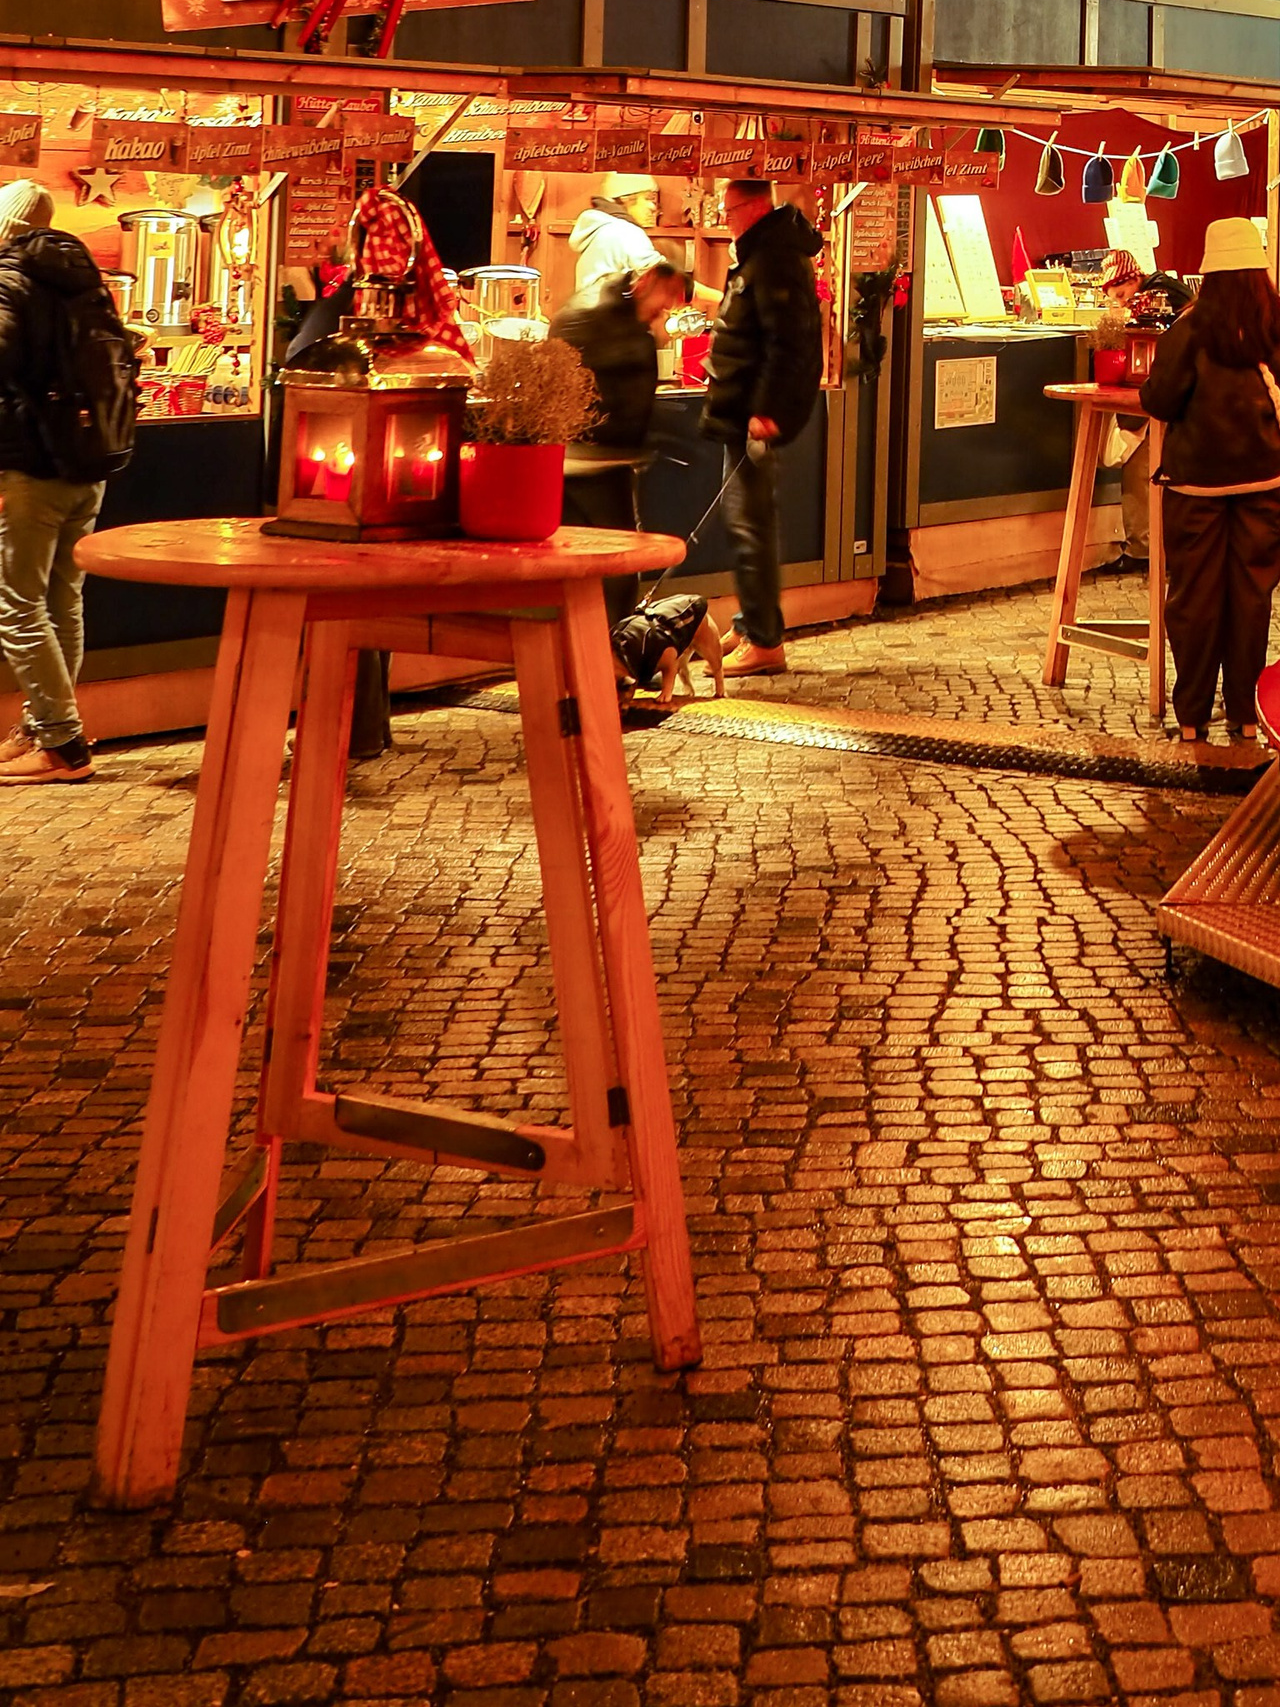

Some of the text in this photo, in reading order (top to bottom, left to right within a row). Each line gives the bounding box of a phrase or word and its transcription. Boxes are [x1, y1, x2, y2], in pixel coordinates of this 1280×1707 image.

[104, 136, 165, 161] Kakao
[344, 129, 411, 149] irsch-Vanille
[189, 142, 252, 163] Apfel Zimt
[263, 137, 341, 162] chneeweißchen
[513, 140, 588, 162] Apfelschorle
[595, 140, 645, 160] ch-Vanille
[665, 144, 693, 162] Apfel
[959, 163, 988, 175] Zimt
